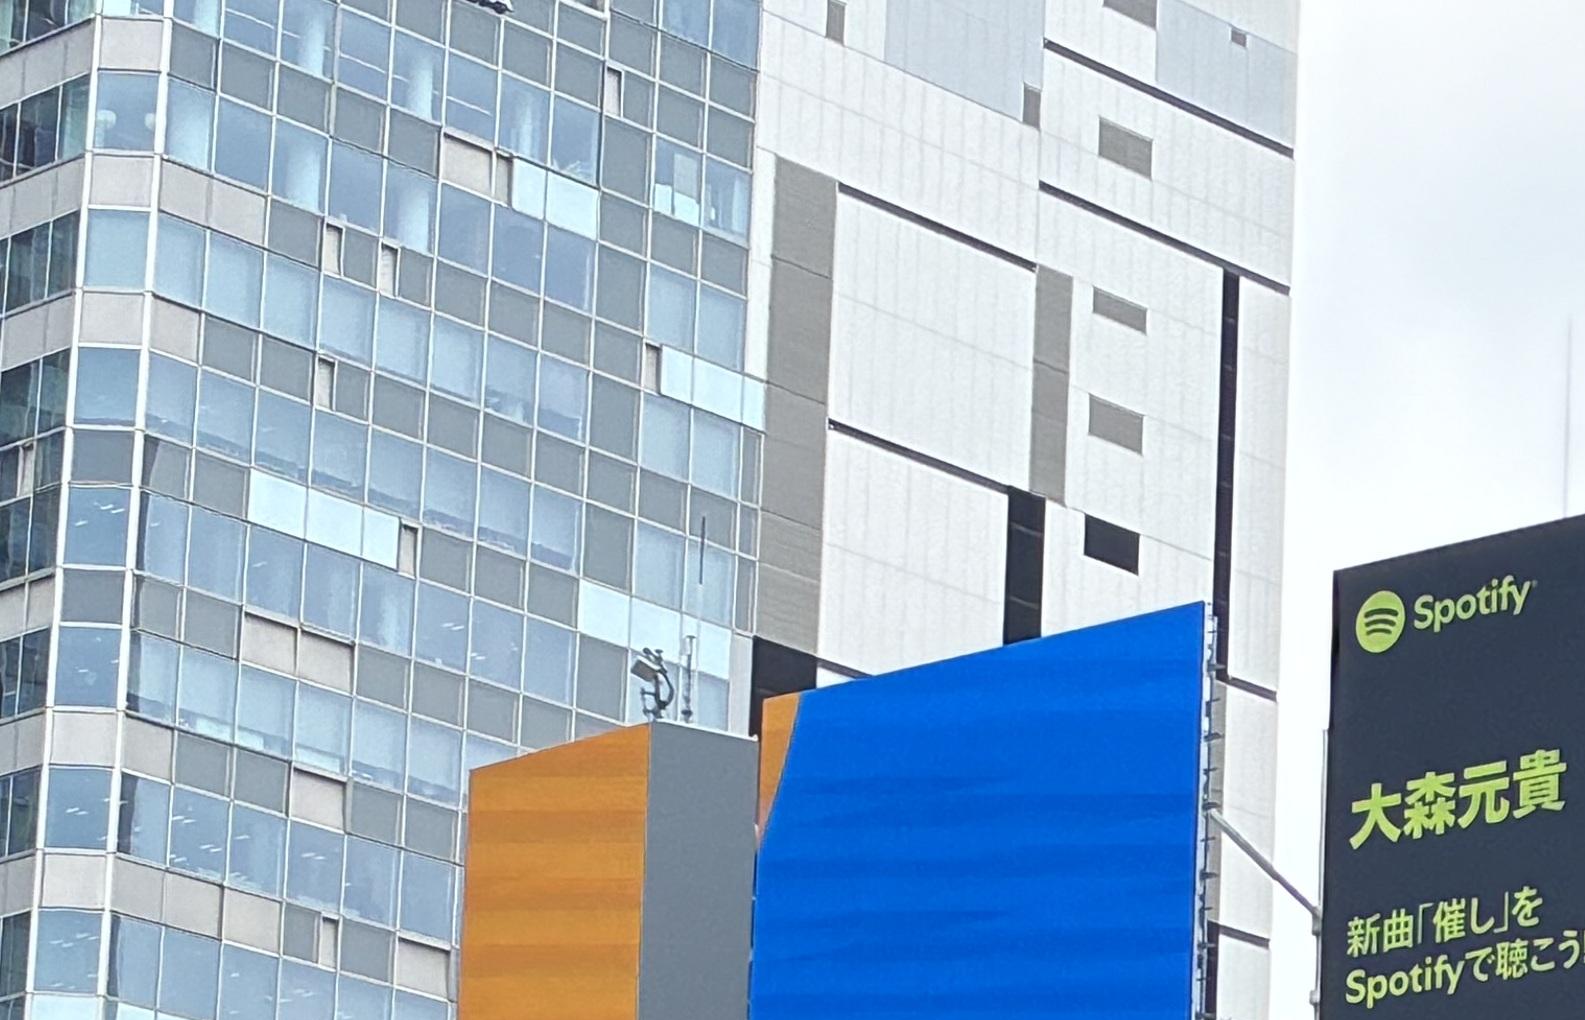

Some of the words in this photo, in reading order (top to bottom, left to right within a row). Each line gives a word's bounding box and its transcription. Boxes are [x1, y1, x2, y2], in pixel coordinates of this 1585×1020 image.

[1413, 574, 1532, 633] Spotify
[1349, 748, 1568, 850] 大森元貴
[1346, 885, 1544, 958] 新曲「催し」を
